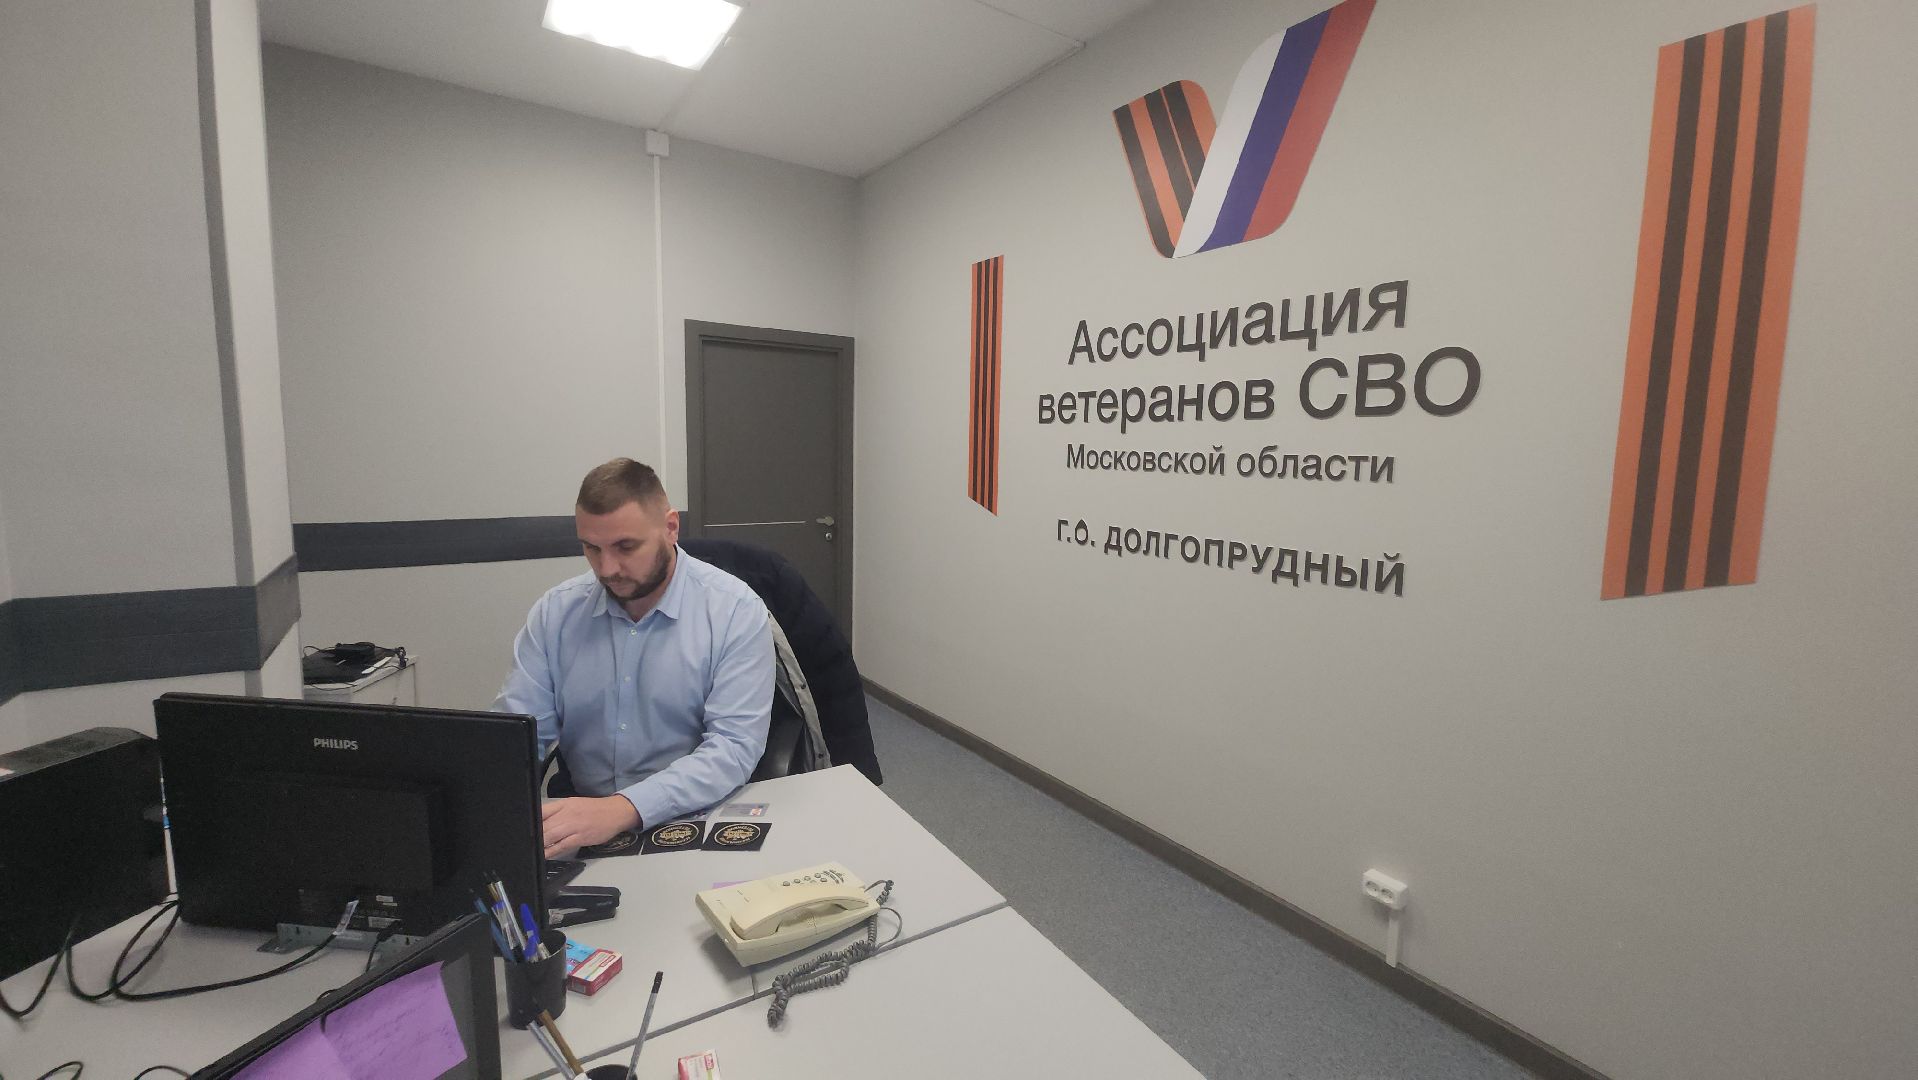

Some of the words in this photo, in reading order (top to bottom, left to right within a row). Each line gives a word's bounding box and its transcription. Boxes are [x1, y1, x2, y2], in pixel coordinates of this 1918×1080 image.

[1067, 279, 1409, 365] Ассоциация
[1038, 378, 1276, 435] ветеранов
[1299, 346, 1481, 420] СВО
[1066, 444, 1226, 476] Московской
[1236, 444, 1395, 484] области
[1103, 525, 1406, 598] ДОЛГОПРУДНЫЙ
[313, 737, 359, 750] PHILIPS
